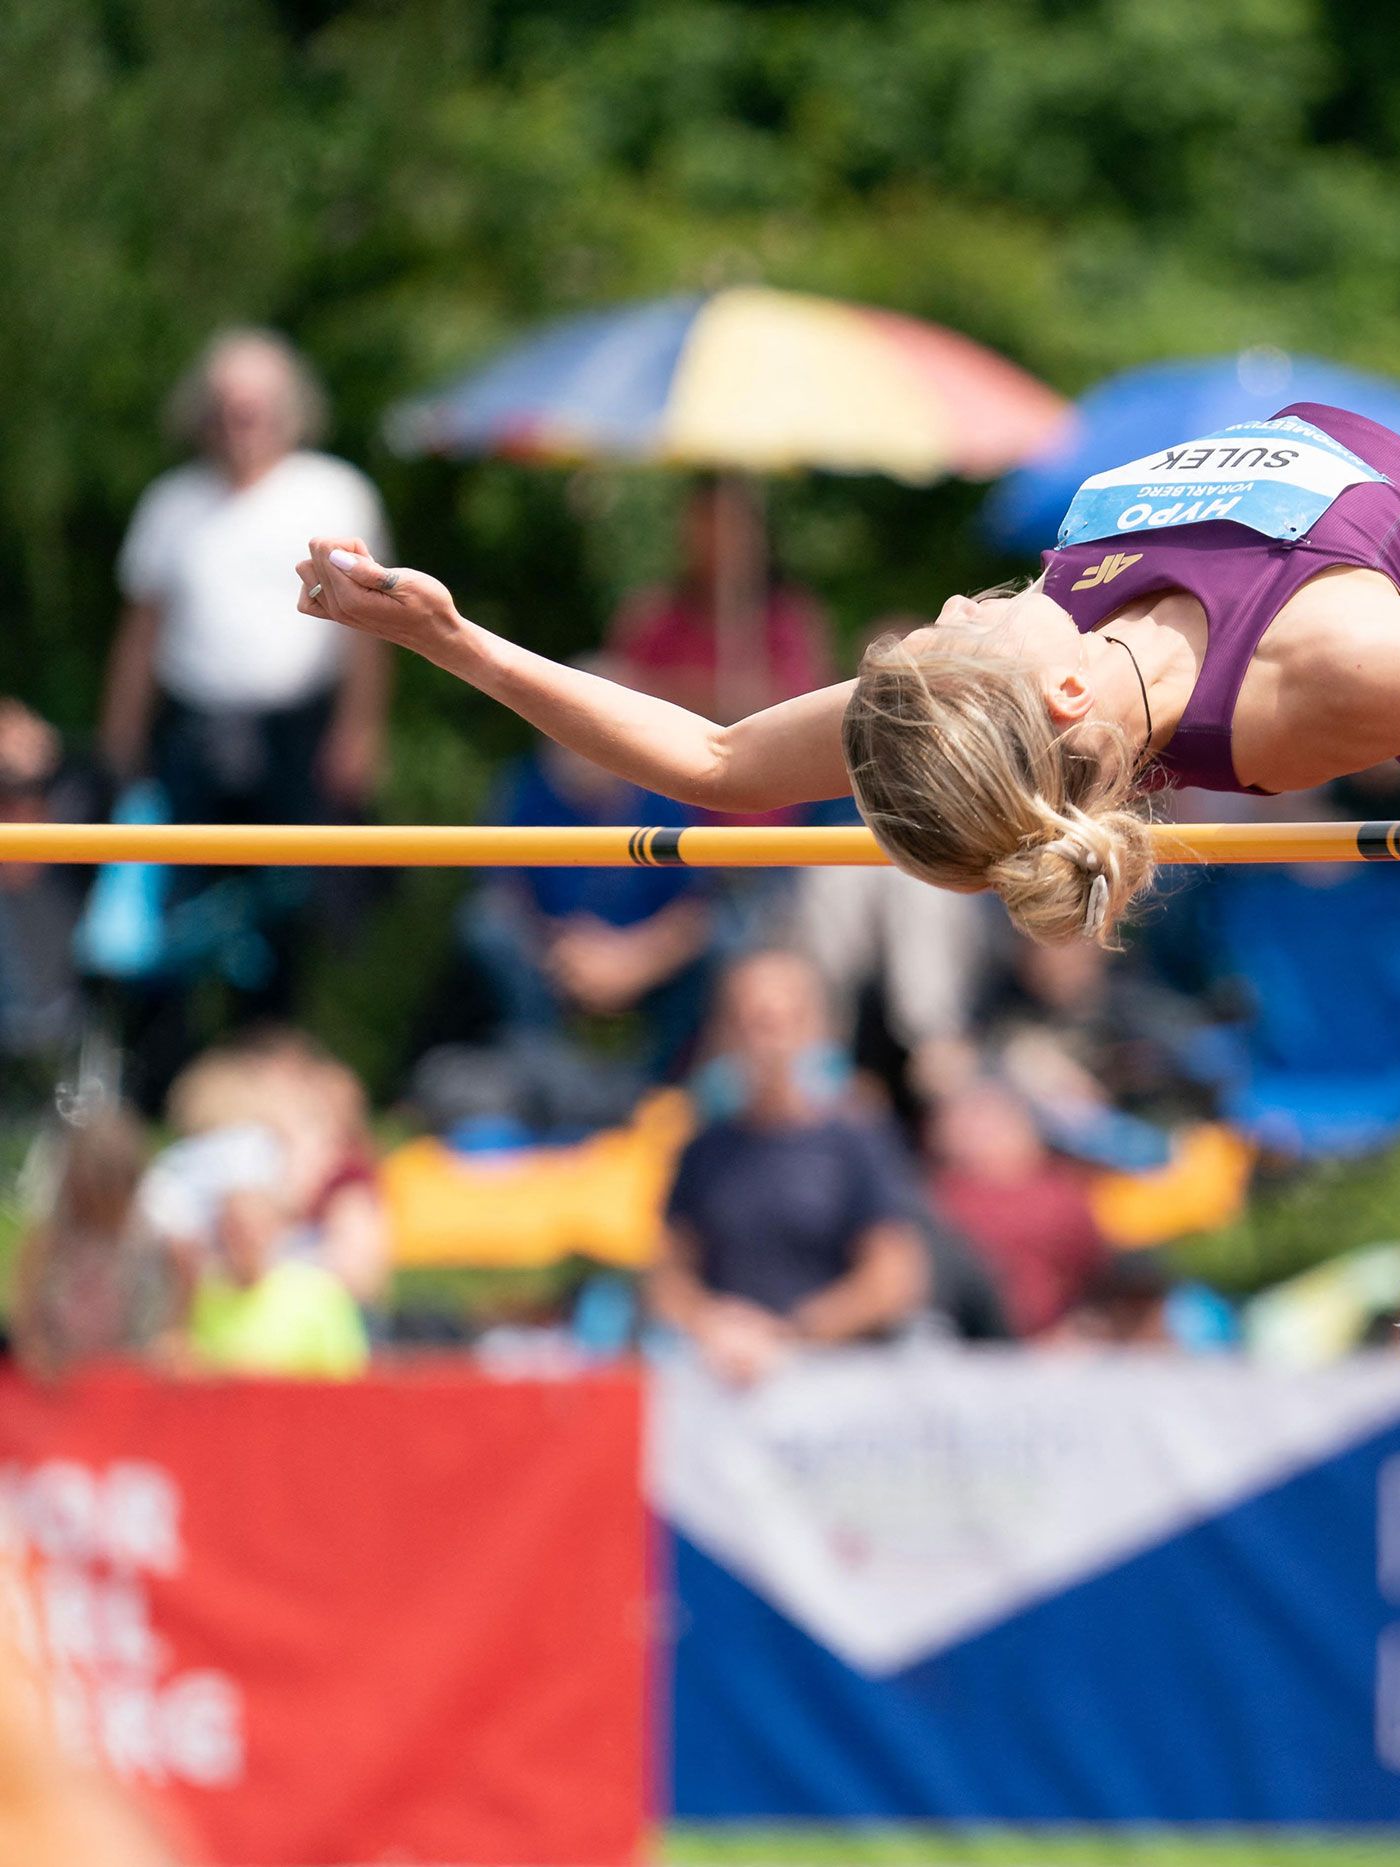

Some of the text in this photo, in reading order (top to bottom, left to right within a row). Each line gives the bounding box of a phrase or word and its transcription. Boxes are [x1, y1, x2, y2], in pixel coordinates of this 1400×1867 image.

[1150, 447, 1300, 471] SULEK
[1136, 481, 1255, 498] VORARLBERG
[1116, 495, 1243, 530] HYPO
